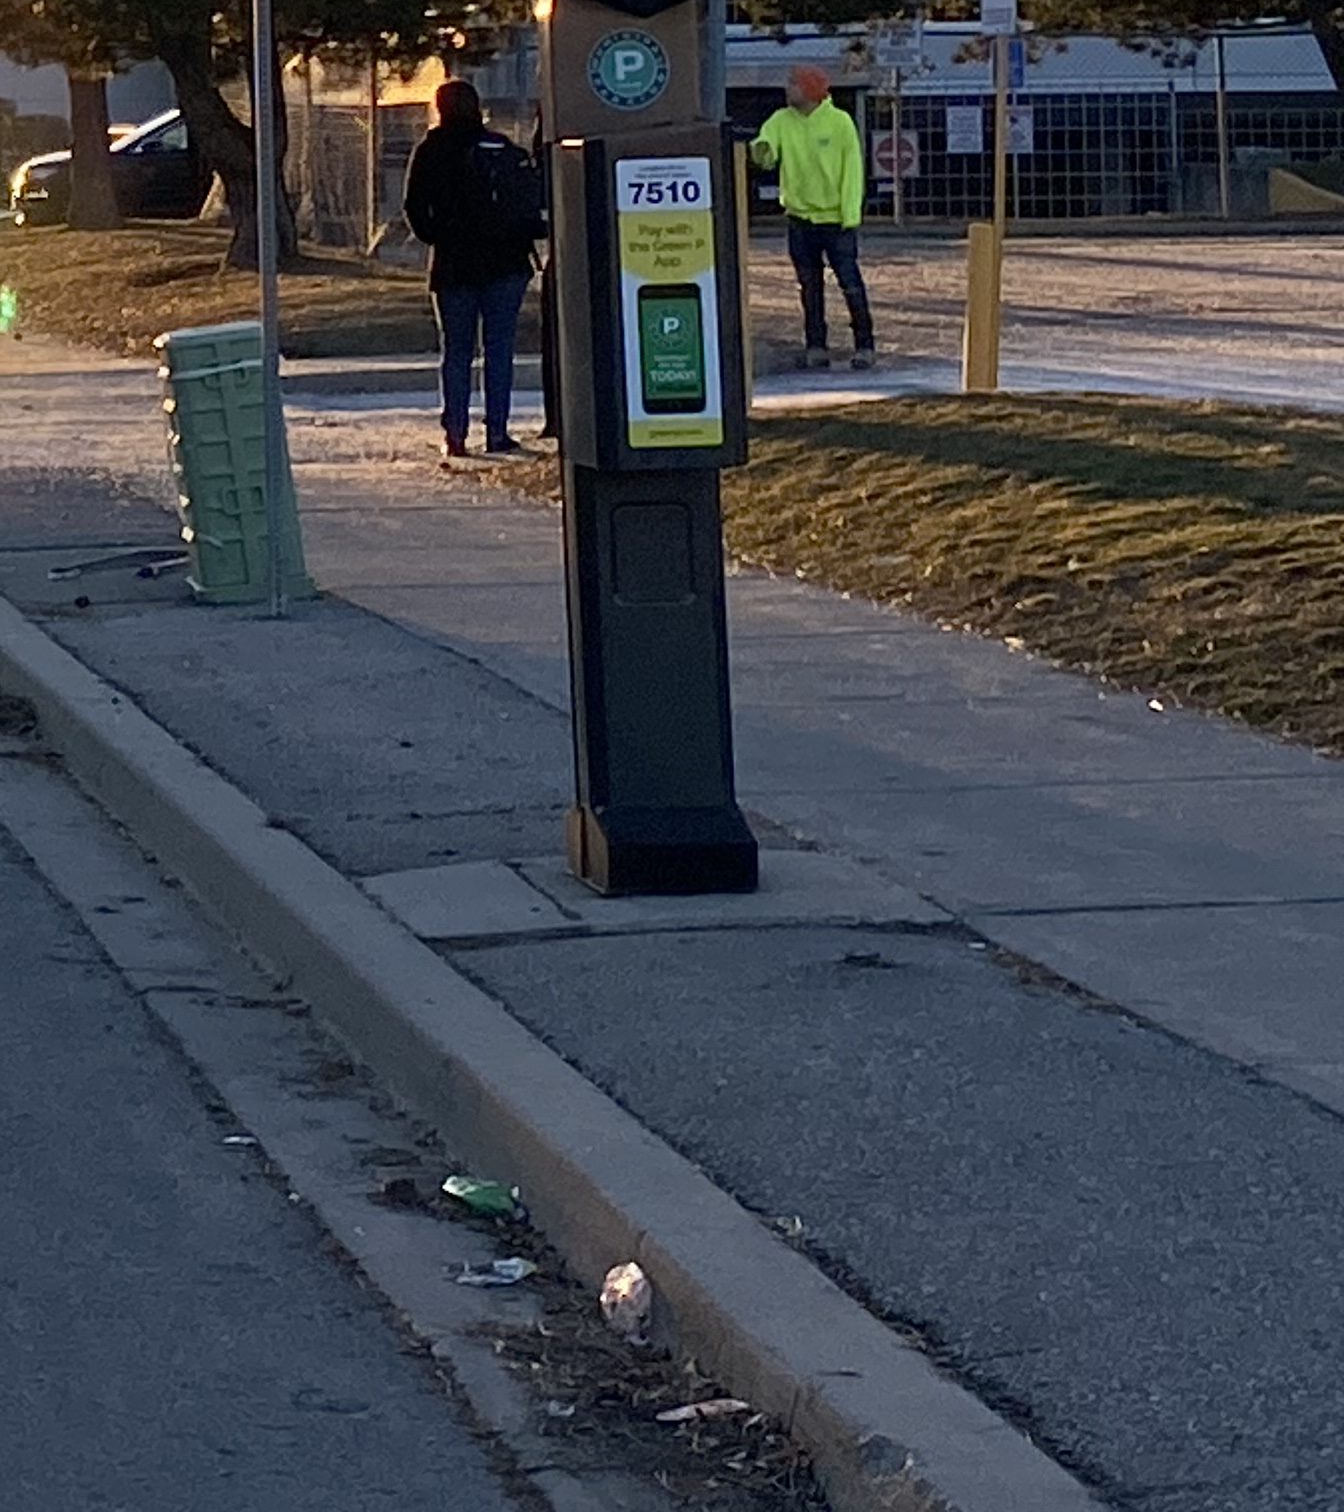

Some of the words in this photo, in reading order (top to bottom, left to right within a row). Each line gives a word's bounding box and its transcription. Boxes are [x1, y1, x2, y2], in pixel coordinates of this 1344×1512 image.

[614, 50, 645, 80] P
[628, 181, 700, 204] 7510
[663, 316, 680, 335] P
